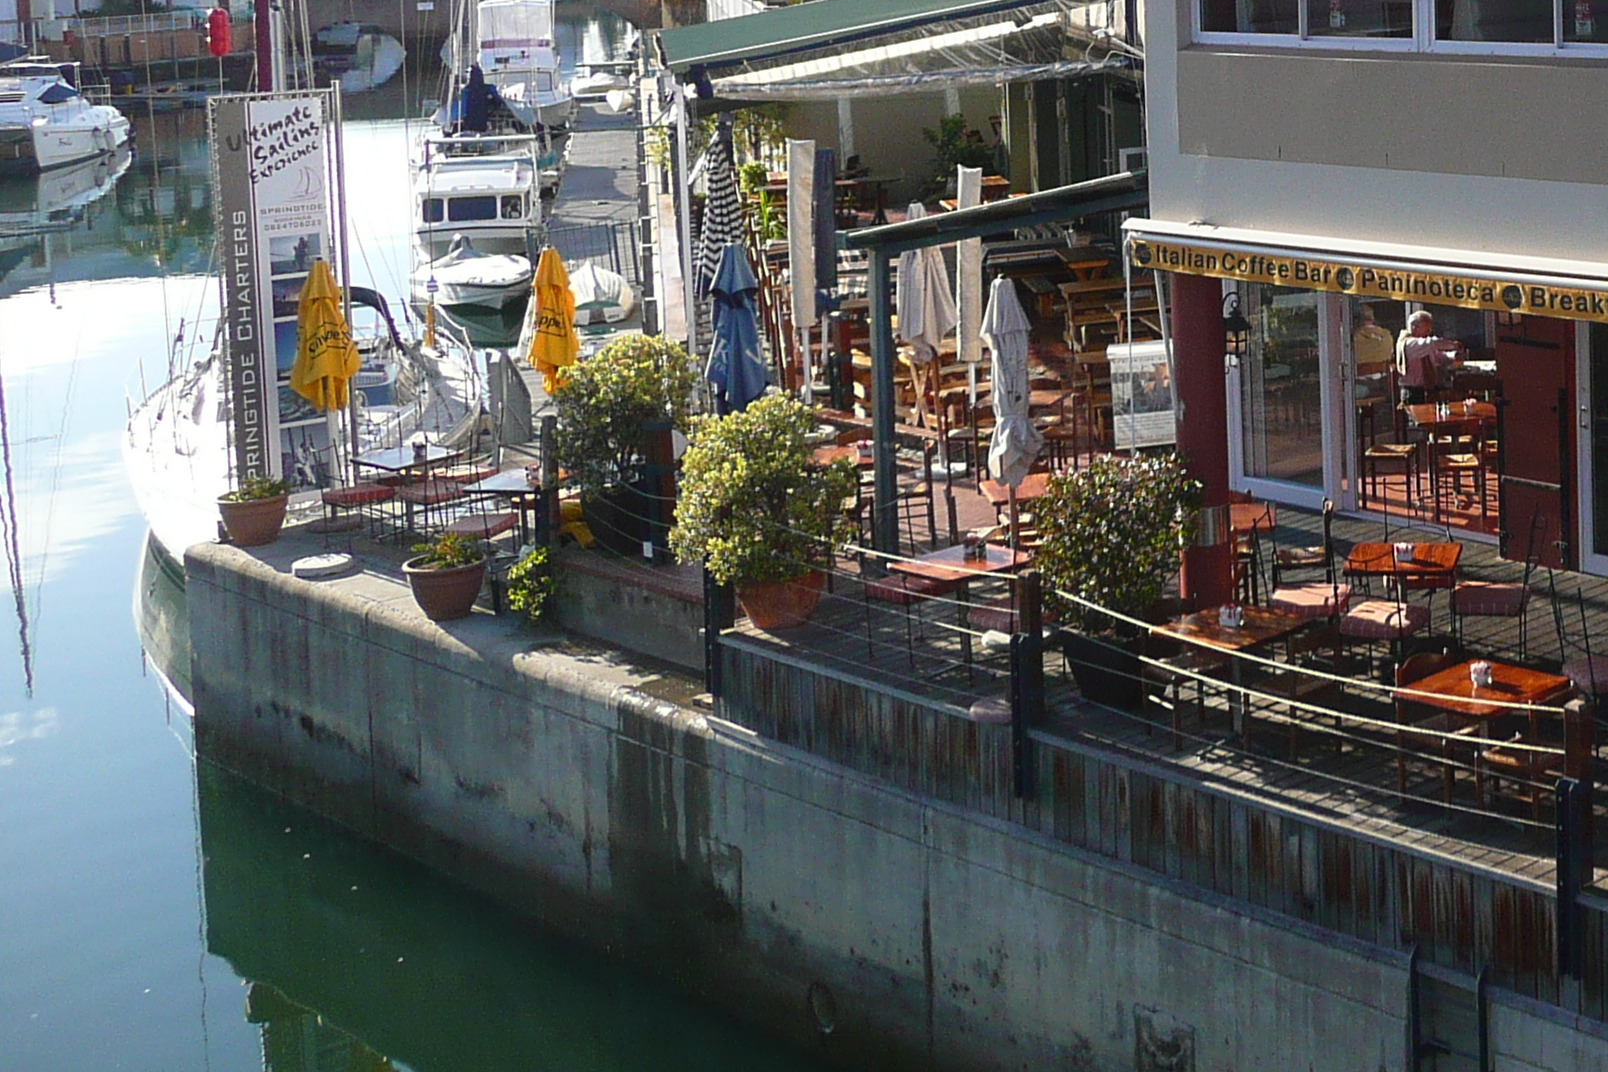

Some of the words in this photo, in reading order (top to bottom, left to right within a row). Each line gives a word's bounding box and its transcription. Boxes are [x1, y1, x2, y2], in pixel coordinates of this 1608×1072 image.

[226, 106, 312, 152] Ultimate
[250, 141, 319, 185] Experience
[260, 203, 325, 215] SPRINGTIDE
[233, 210, 252, 341] CHARTERS
[1155, 245, 1217, 270] Italian
[1222, 252, 1290, 279] Coffee
[1294, 261, 1332, 284] Bar
[1361, 268, 1495, 303] Paninoteca
[241, 352, 261, 481] PRINGTIDE
